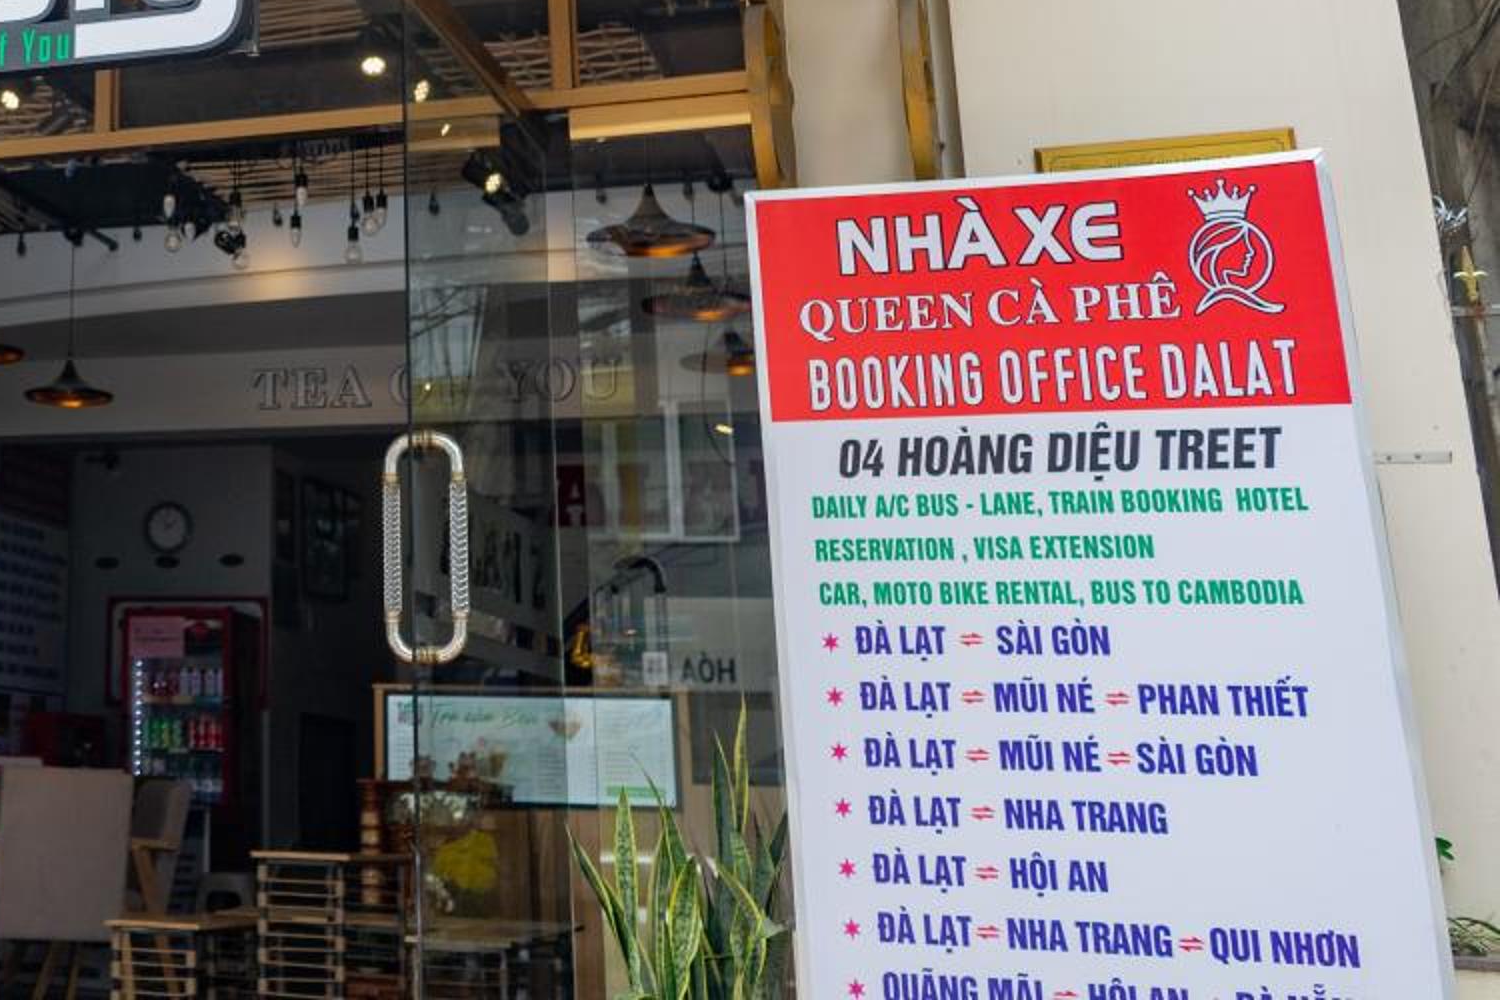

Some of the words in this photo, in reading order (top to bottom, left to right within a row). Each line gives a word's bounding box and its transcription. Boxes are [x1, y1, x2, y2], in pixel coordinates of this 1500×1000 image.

[23, 29, 69, 64] You
[836, 198, 1007, 276] NHÀ
[1013, 202, 1124, 264] XE
[799, 291, 975, 341] QUEEN
[987, 278, 1060, 327] CÀ
[1071, 272, 1182, 322] PHÊ
[253, 365, 372, 410] TEA
[504, 357, 620, 401] YOU
[808, 350, 983, 411] BOOKING
[999, 345, 1146, 405] OFFICE
[1159, 338, 1297, 399] DALAT
[839, 438, 884, 478] 04
[898, 425, 1033, 474] HOÀNG
[1047, 422, 1141, 483] DIỆU
[1156, 426, 1281, 470] TREET
[812, 495, 868, 518] DAILY
[875, 495, 909, 518] A/C
[917, 494, 958, 517] BUS
[980, 492, 1044, 517] LANE,
[1049, 490, 1114, 514] TRAIN
[1121, 488, 1223, 513] BOOKING
[1235, 487, 1309, 512] HOTEL
[815, 538, 954, 562] RESERVATION
[974, 536, 1022, 560] VISA
[1030, 535, 1154, 559] EXTENSION
[819, 583, 868, 607] CAR,
[873, 582, 933, 605] MOTO
[940, 581, 988, 605] BIKE
[996, 581, 1084, 607] RENTAL,
[1090, 580, 1136, 604] BUS
[1142, 580, 1171, 604] TO
[1177, 579, 1304, 605] CAMBODIA
[855, 620, 892, 656] ĐÀ
[899, 626, 945, 663] LẠT
[996, 620, 1043, 656] SÀI
[1051, 620, 1111, 657] GÒN
[860, 677, 897, 712] ĐÀ
[904, 682, 951, 720] LẠT
[994, 677, 1049, 713] MŨI
[1056, 677, 1095, 714] NÉ
[1138, 683, 1218, 716] PHAN
[1227, 676, 1309, 718] THIẾT
[864, 731, 901, 768] ĐÀ
[909, 739, 956, 778] LẠT
[1000, 735, 1053, 773] MŨI
[1063, 735, 1100, 773] NÉ
[1137, 738, 1186, 776] SÀI
[1196, 738, 1257, 778] GÒN
[869, 788, 905, 827] ĐÀ
[915, 797, 961, 835] LẠT
[1005, 799, 1064, 832] NHA
[1072, 800, 1168, 835] TRANG
[873, 845, 910, 885] ĐÀ
[918, 855, 966, 895] LẠT
[1009, 852, 1058, 898] HỘI
[1068, 860, 1109, 893] AN
[877, 904, 915, 944] ĐÀ
[923, 914, 972, 954] LẠT
[1007, 918, 1068, 952] NHA
[1075, 921, 1173, 958] TRANG
[1209, 927, 1261, 964] QUI
[1270, 932, 1361, 969] NHƠN
